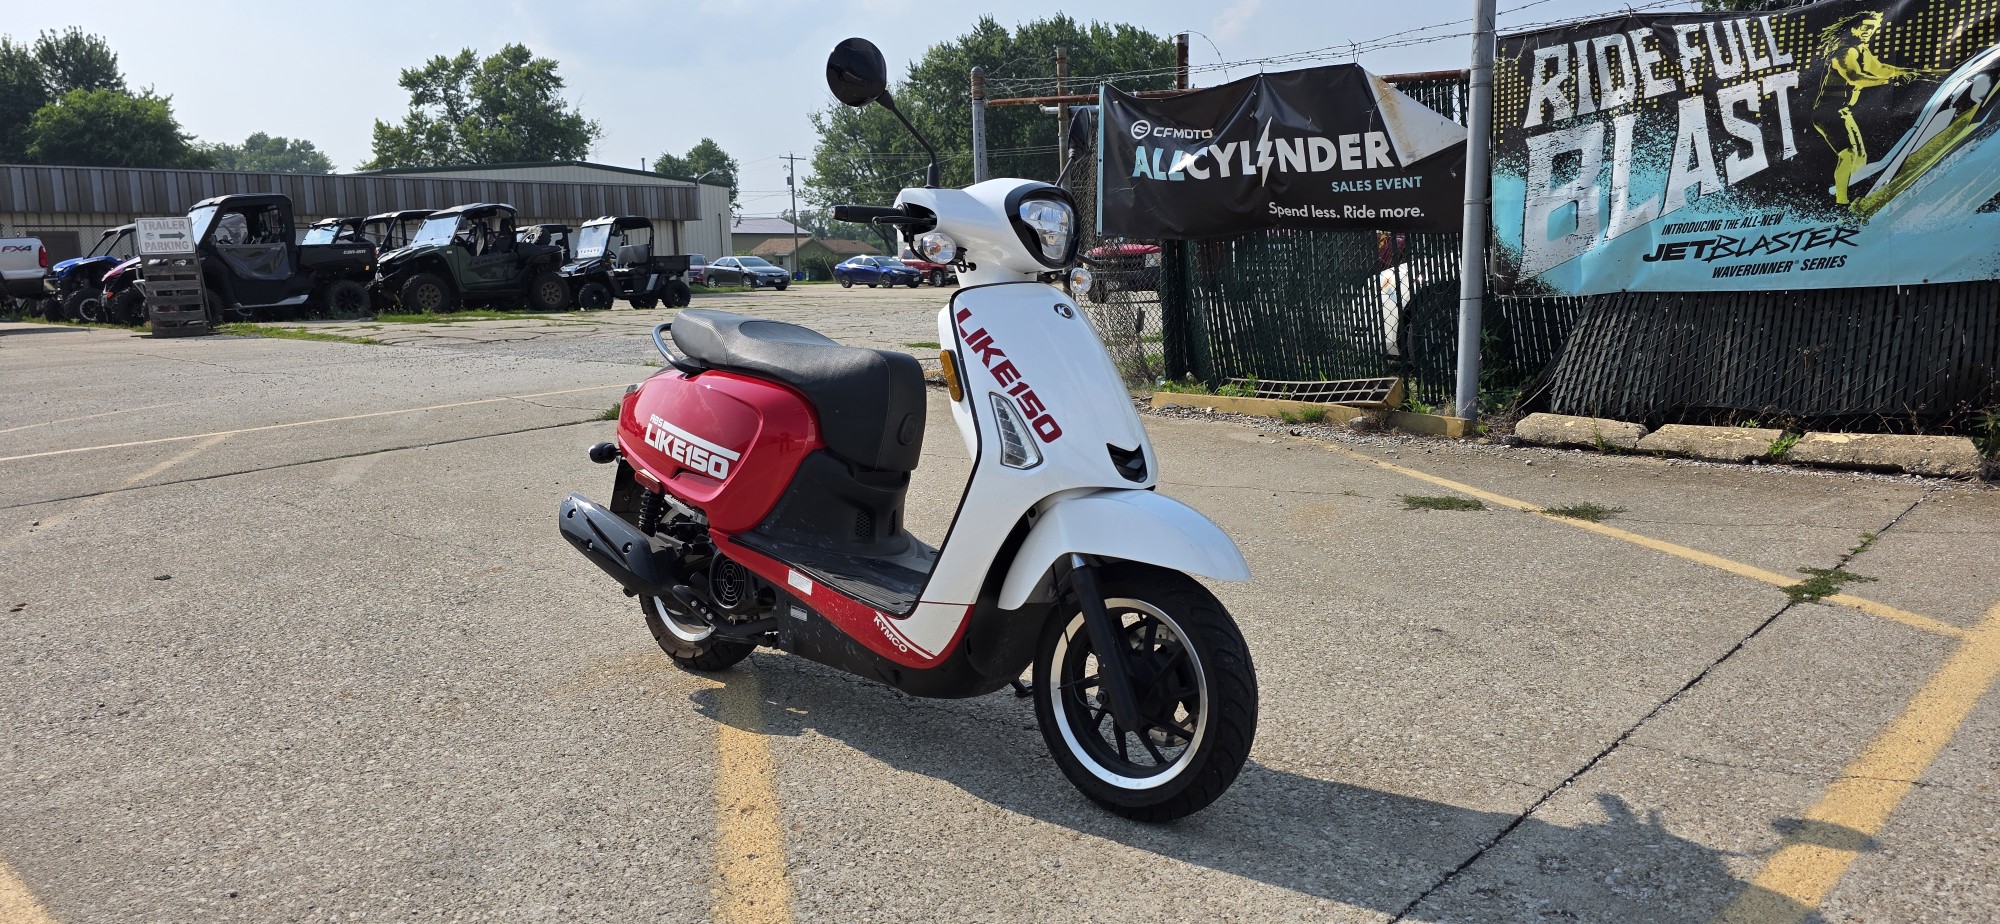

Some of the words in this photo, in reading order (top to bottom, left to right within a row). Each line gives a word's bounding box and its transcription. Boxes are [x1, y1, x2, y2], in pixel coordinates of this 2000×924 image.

[1523, 28, 1677, 129] RIDE
[1672, 16, 1797, 88] FULL
[1153, 127, 1213, 139] CFMOTO
[1332, 179, 1372, 193] SALES
[1376, 176, 1423, 190] EVENT
[1517, 72, 1799, 281] BLAST
[1269, 202, 1308, 218] Spend
[1311, 204, 1340, 219] less.
[1344, 205, 1375, 219] Ride
[1379, 206, 1425, 218] more.
[142, 220, 186, 231] TRAILER
[1662, 219, 1721, 235] INTRODUCING
[1725, 218, 1740, 229] THE
[1741, 213, 1785, 228] ALL-NEW
[145, 240, 189, 252] PARKING
[1800, 255, 1848, 271] SERIES
[956, 308, 1062, 443] LIKE150
[650, 414, 664, 428] ABS
[644, 423, 729, 480] LIKE150
[873, 616, 908, 653] KYMCO
